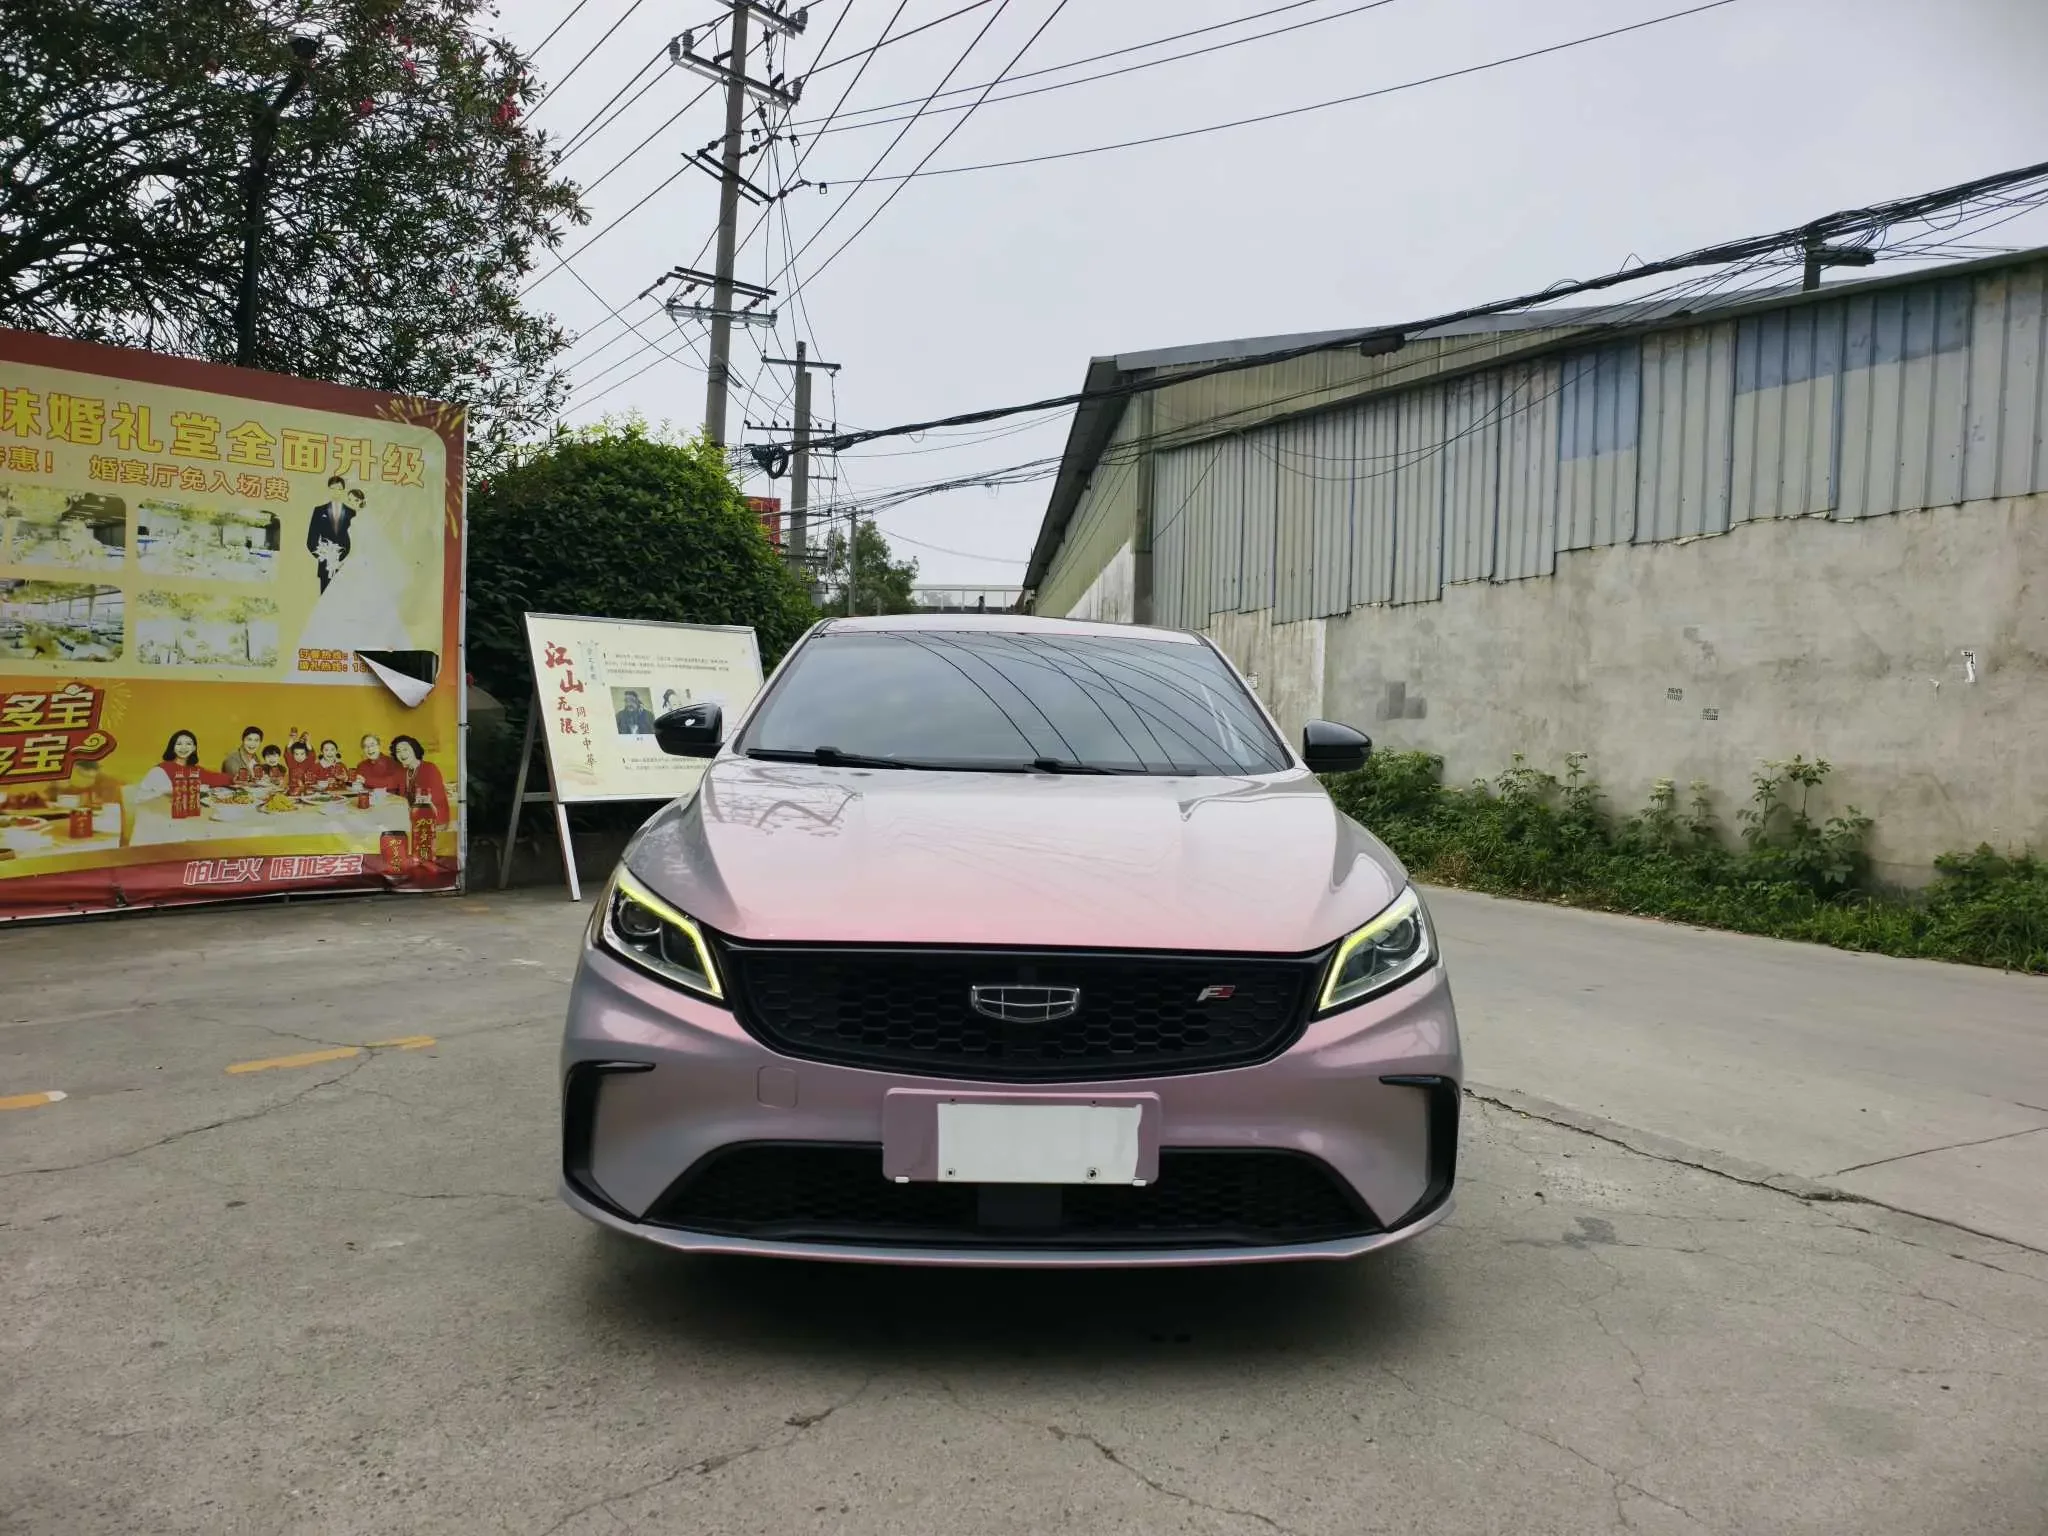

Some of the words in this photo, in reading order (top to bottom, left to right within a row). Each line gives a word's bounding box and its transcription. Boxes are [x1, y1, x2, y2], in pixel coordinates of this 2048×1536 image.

[0, 445, 55, 474] 惠！
[89, 454, 290, 502] 婚宴厅免入场费
[184, 857, 264, 886] 怕上火
